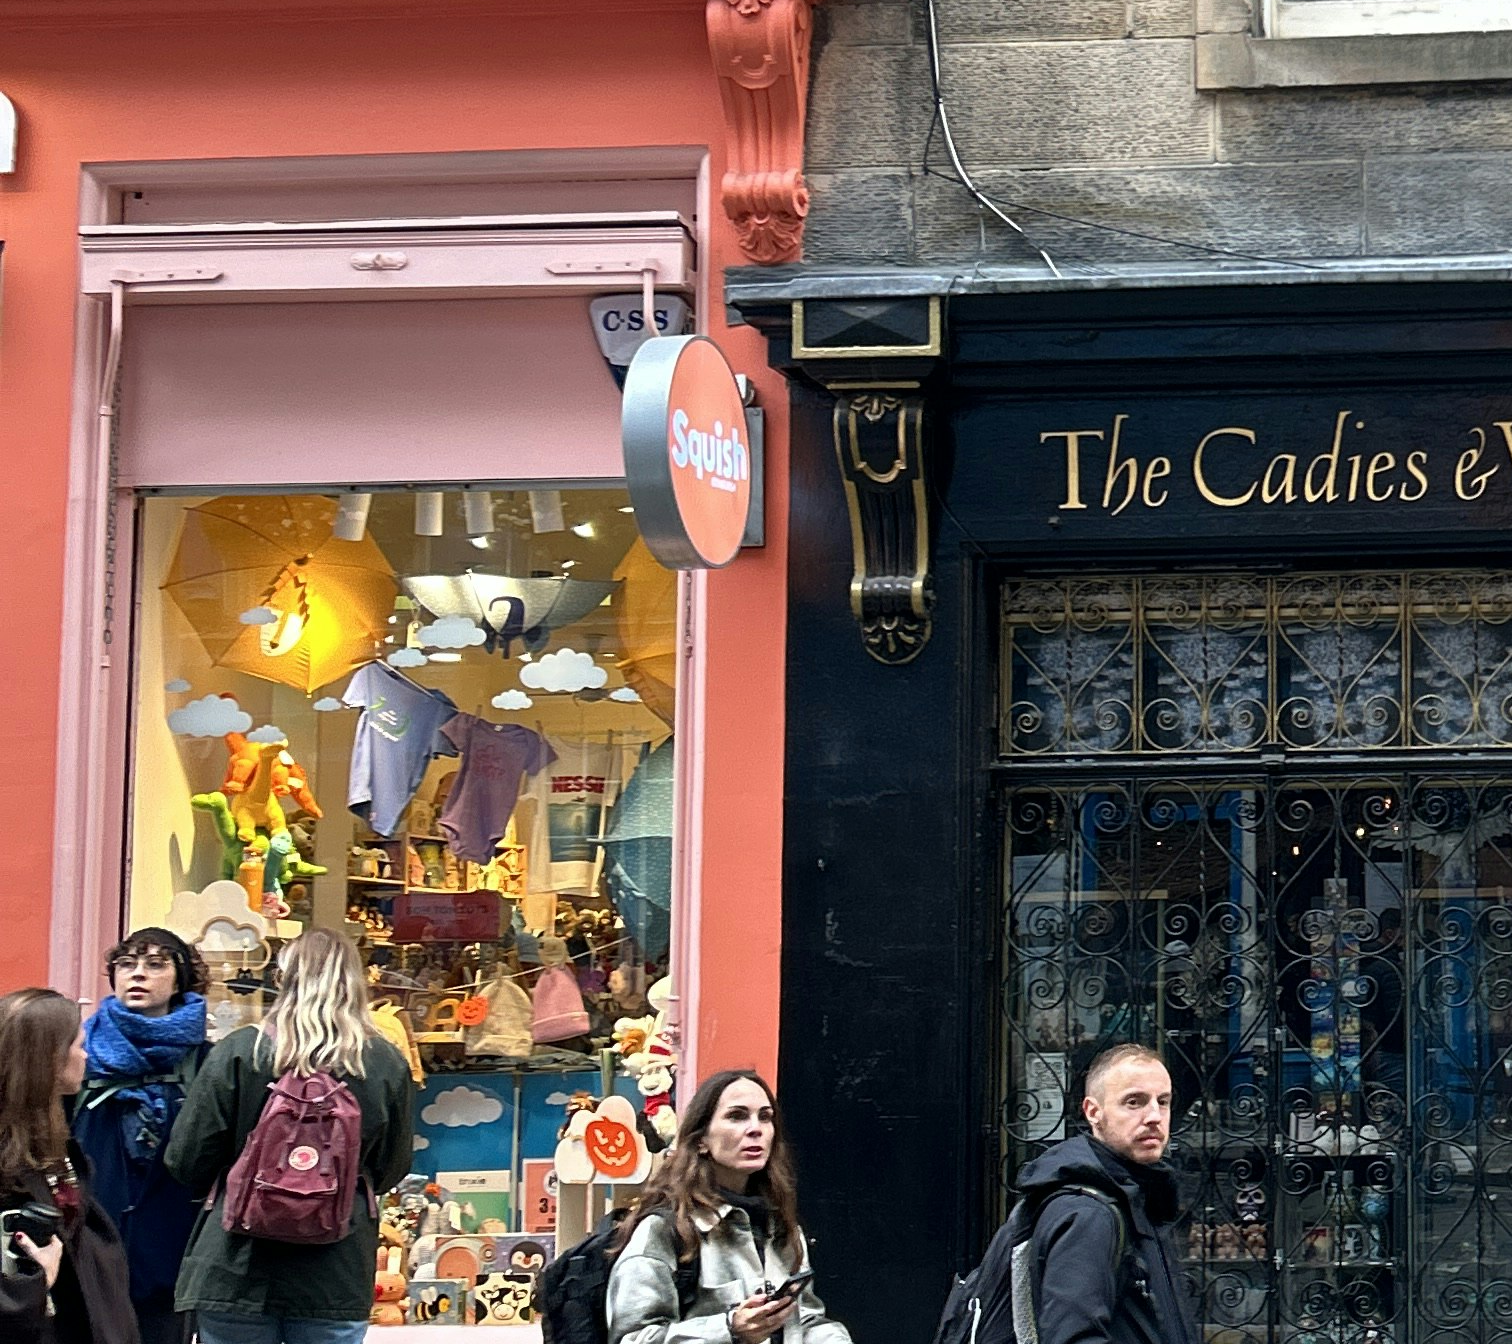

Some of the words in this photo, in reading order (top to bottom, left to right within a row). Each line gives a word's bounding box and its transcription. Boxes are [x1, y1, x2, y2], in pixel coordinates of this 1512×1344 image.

[671, 408, 748, 481] Squish
[1041, 415, 1170, 515] The
[1195, 412, 1427, 506] Cadies
[539, 1197, 549, 1214] 3
